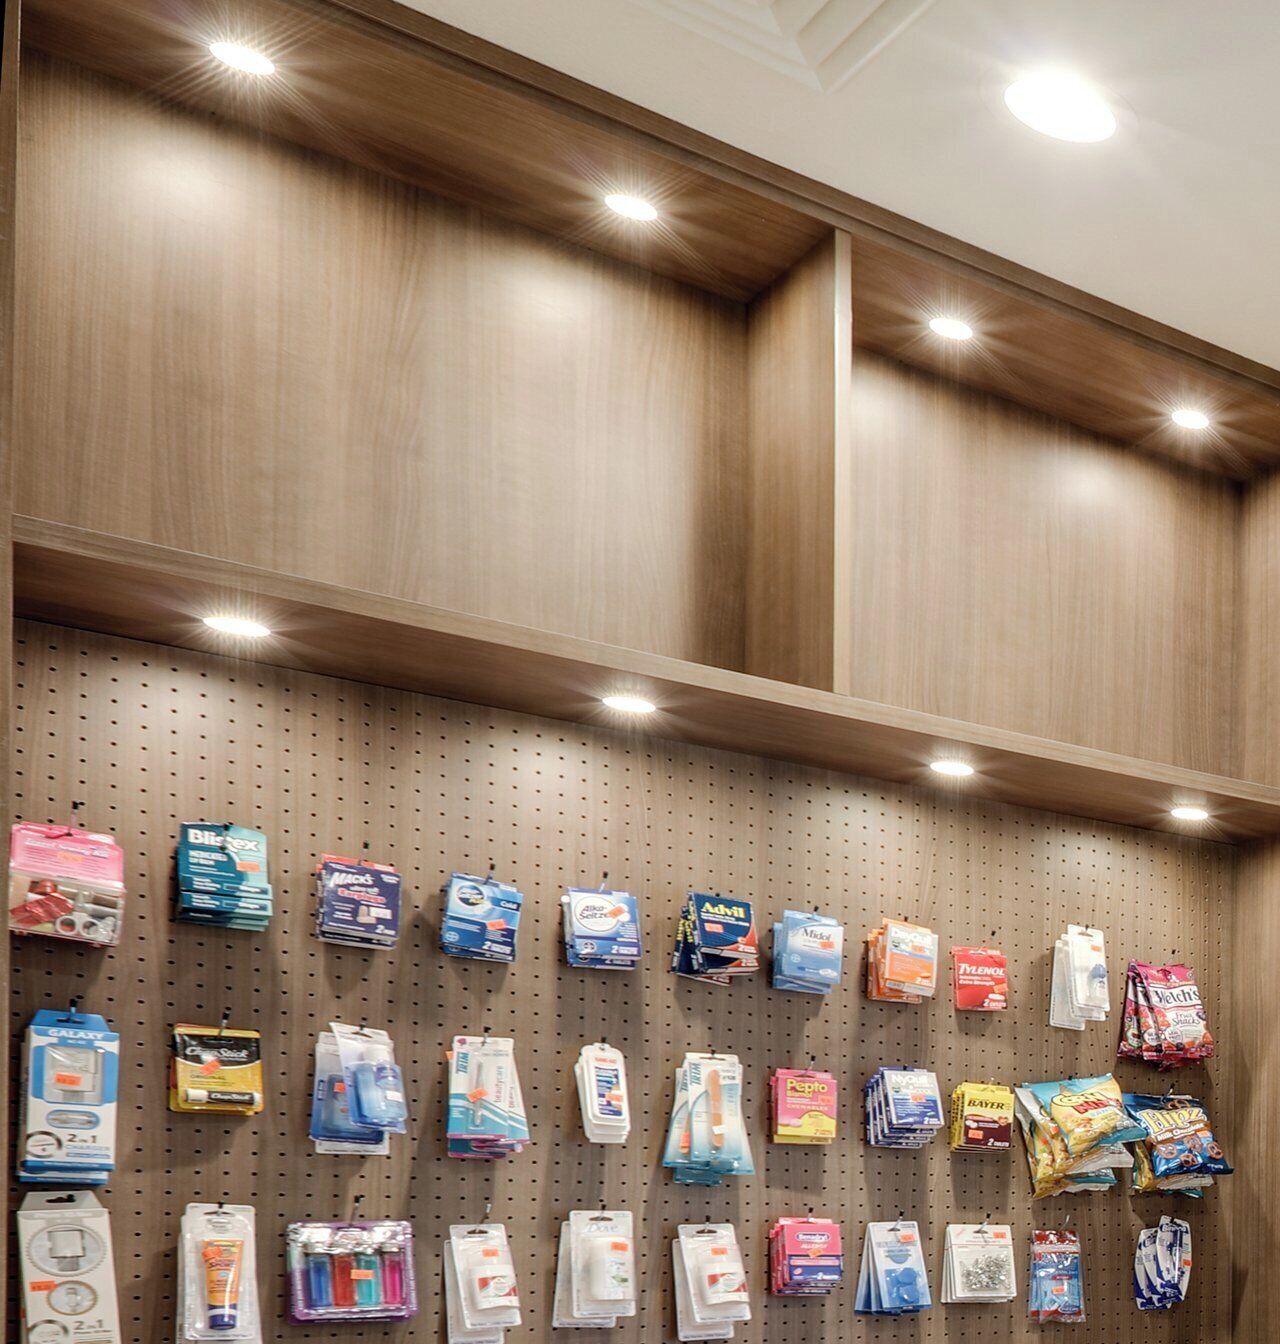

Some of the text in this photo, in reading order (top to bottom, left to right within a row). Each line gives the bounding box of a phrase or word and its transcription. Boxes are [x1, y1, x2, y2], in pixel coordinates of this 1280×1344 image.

[702, 902, 745, 919] Advil
[802, 928, 833, 942] Midol
[958, 963, 1005, 976] TYLENOL
[1154, 988, 1200, 1006] Welch's
[48, 1030, 104, 1040] GALAXY
[455, 1052, 469, 1074] TRIM
[689, 1062, 701, 1086] TRIM
[786, 1079, 828, 1093] Pepto
[968, 1100, 1004, 1110] BAYER
[1141, 1108, 1205, 1131] Flipz
[1156, 1130, 1172, 1141] Milk
[587, 1222, 618, 1233] Dove
